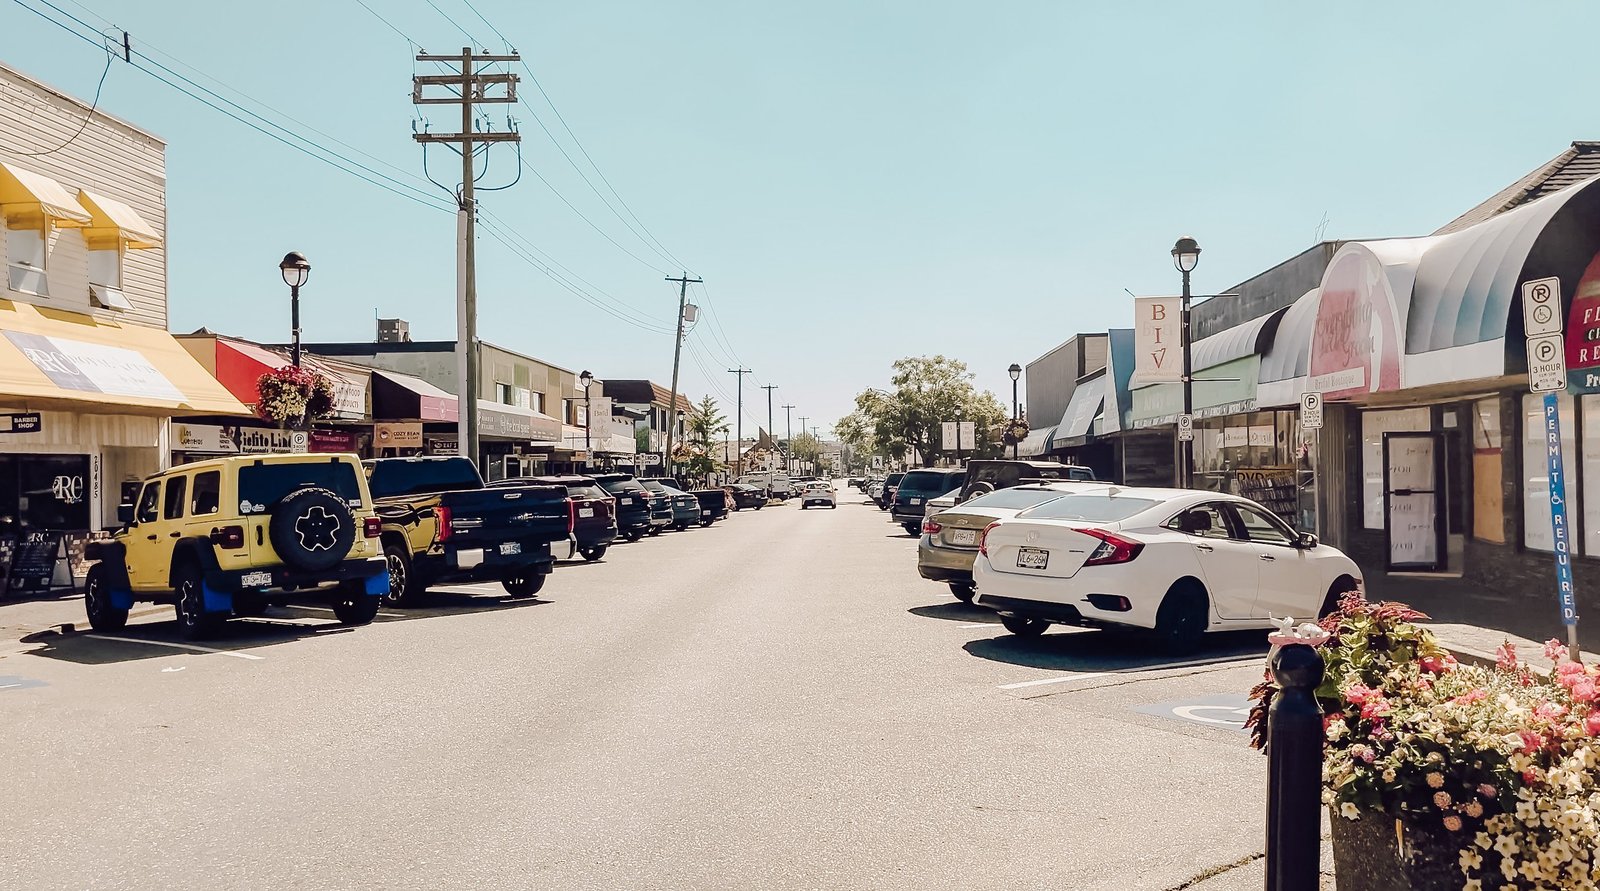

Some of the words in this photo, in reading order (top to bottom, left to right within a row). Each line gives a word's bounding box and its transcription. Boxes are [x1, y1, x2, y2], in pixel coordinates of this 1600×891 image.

[1151, 304, 1166, 368] BIV
[1533, 366, 1539, 374] 3
[1540, 363, 1561, 373] HOUR
[349, 388, 360, 397] FOOD
[1547, 406, 1559, 483] PERMIT
[54, 475, 83, 499] RC
[1554, 514, 1573, 619] REQUIRED
